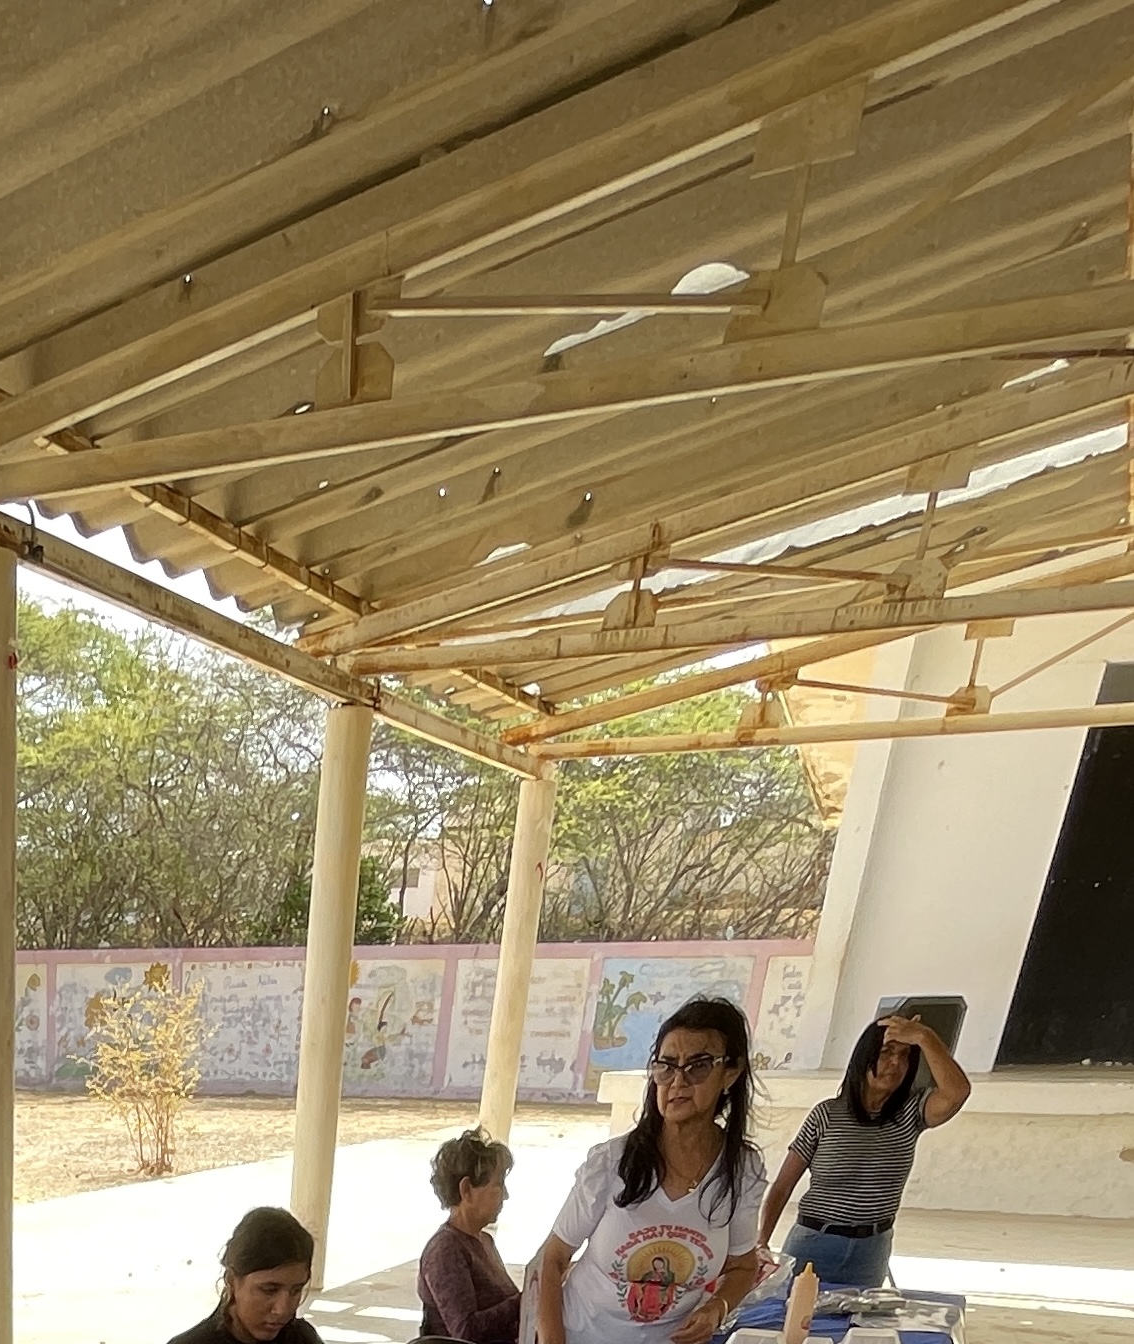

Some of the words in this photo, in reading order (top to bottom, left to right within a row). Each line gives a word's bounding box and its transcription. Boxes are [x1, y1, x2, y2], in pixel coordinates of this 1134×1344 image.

[615, 1238, 642, 1256] NADA
[642, 1231, 664, 1241] HAY
[628, 1226, 657, 1240] BAJO
[675, 1225, 707, 1242] MANTO
